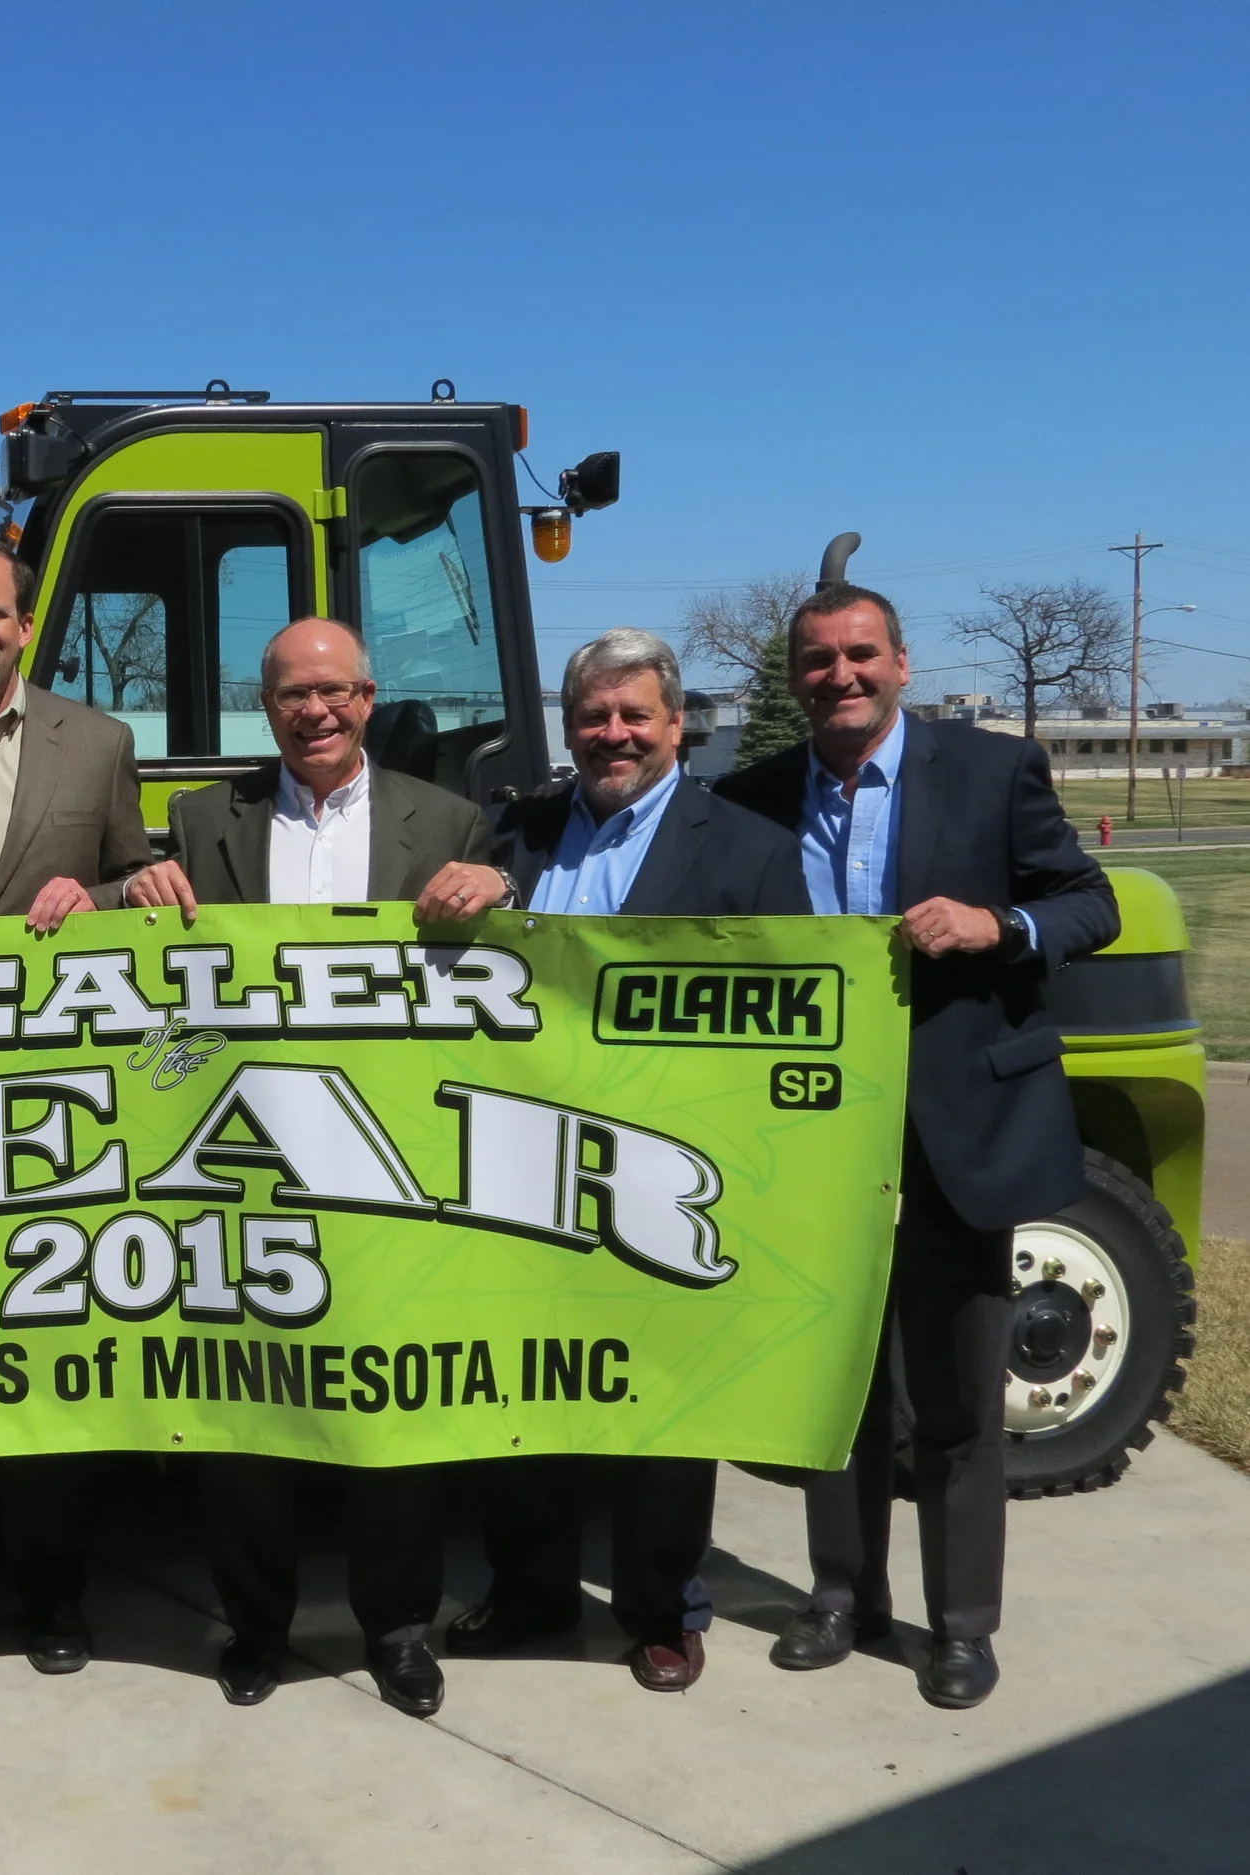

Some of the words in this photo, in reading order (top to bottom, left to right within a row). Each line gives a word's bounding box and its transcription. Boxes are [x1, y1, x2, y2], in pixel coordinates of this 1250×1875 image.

[614, 975, 823, 1038] CLARK
[127, 1017, 187, 1070] of
[151, 1030, 228, 1091] the
[779, 1070, 834, 1103] SP
[0, 1211, 332, 1328] 2015
[54, 1338, 119, 1403] of
[143, 1337, 510, 1413] MINNESOTA,
[521, 1339, 639, 1404] INC.
